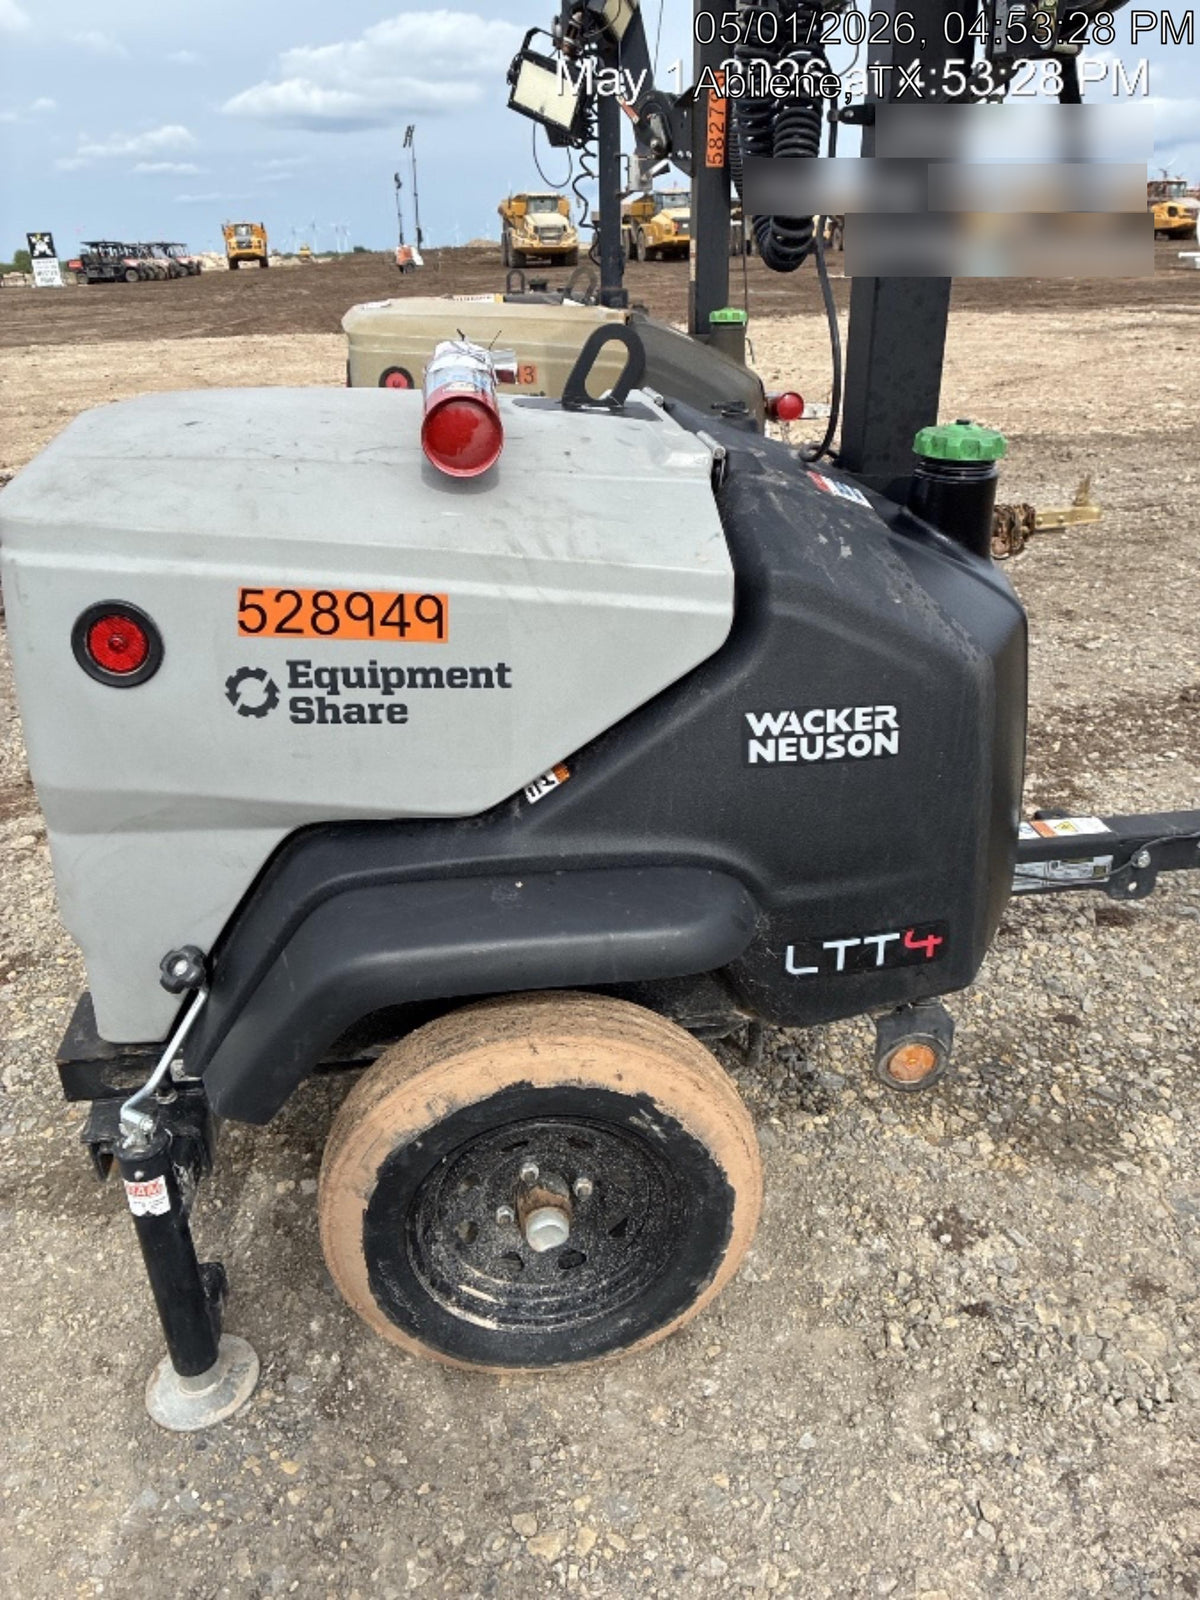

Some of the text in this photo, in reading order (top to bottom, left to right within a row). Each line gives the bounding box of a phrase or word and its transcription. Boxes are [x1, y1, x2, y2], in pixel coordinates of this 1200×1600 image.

[237, 588, 444, 639] 528949
[286, 659, 513, 695] Equipment
[289, 696, 409, 724] Share
[745, 704, 900, 737] WACKER
[748, 730, 899, 763] NEUSON
[784, 928, 943, 976] LTT4
